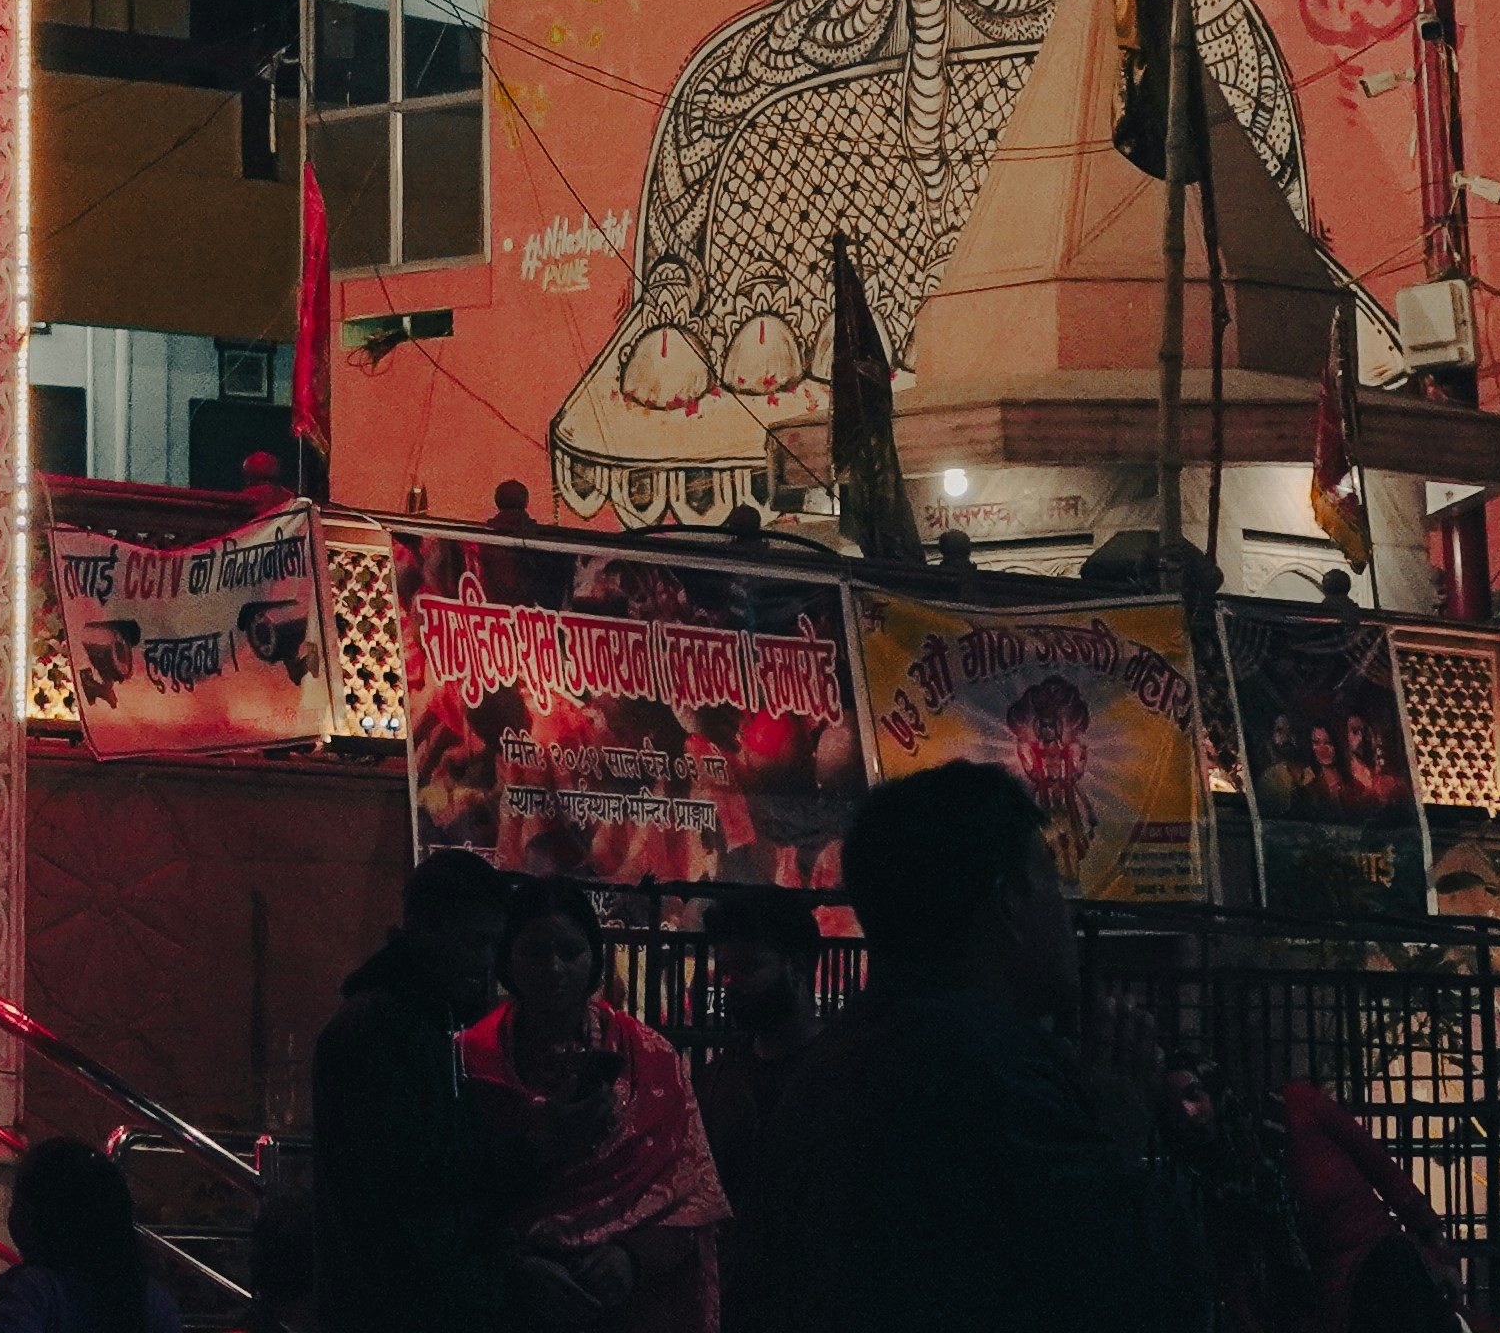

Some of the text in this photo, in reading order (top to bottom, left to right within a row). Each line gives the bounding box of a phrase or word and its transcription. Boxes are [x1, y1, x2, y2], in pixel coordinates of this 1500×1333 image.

[124, 550, 184, 600] CCTV
[514, 604, 563, 716] शुभ
[752, 612, 844, 727] समारोह
[601, 746, 642, 780] साल
